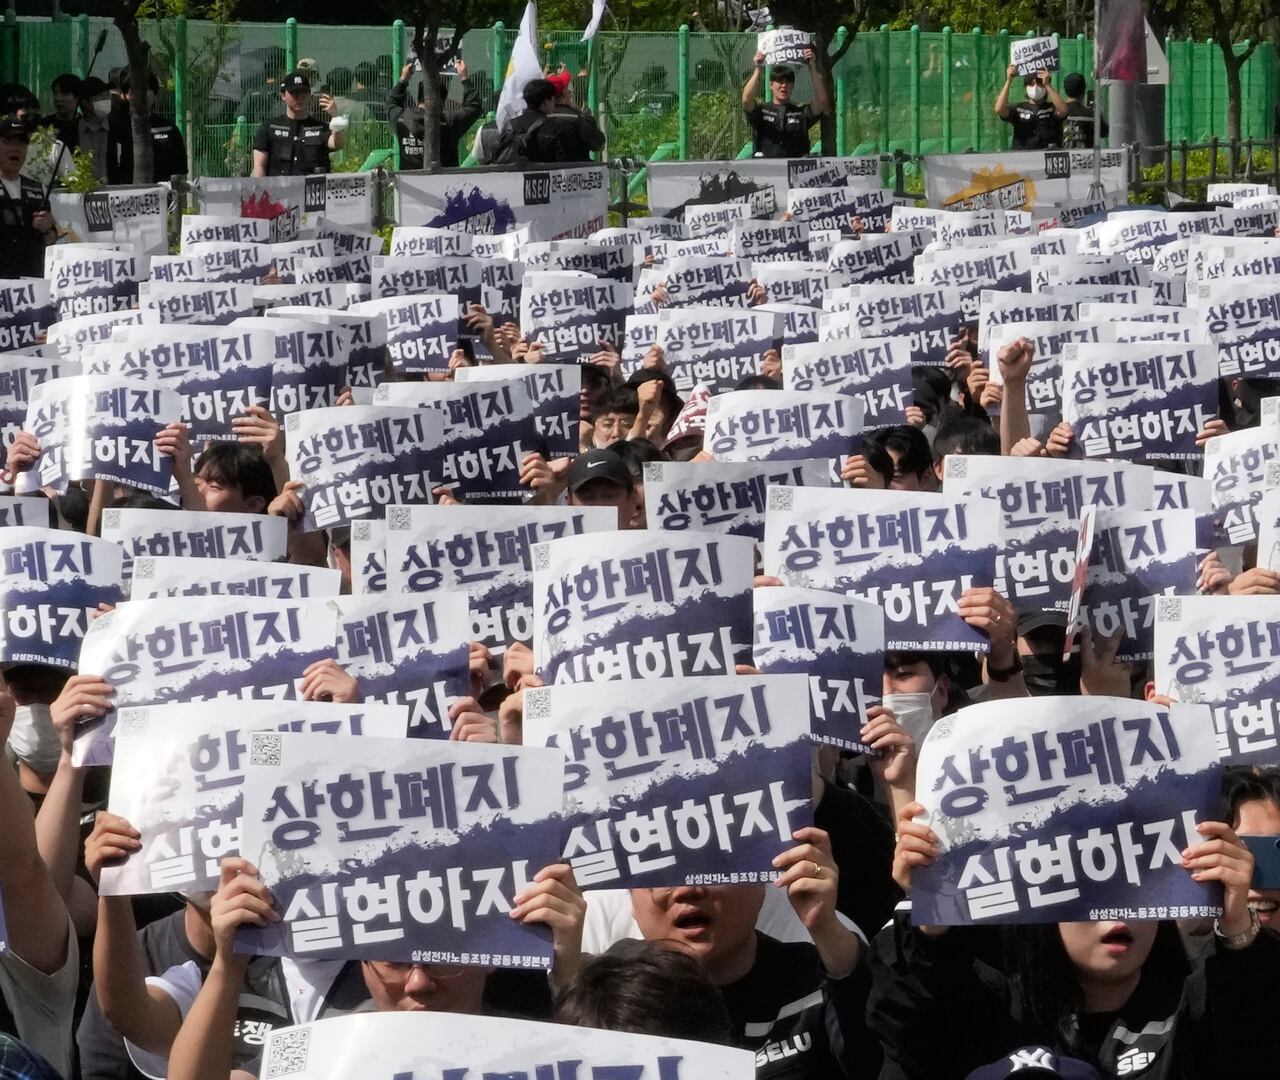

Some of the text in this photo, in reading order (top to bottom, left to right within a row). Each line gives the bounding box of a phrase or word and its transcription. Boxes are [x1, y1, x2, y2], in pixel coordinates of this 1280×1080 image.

[690, 206, 743, 230] 상한폐지
[55, 259, 137, 290] 상한폐지
[378, 265, 470, 295] 상한폐지
[666, 261, 743, 295] 상한폐지
[930, 251, 1016, 287] 상한폐지
[529, 286, 618, 316] 상한폐지
[855, 290, 945, 325] 상한폐지
[662, 316, 758, 350] 상한폐지
[119, 332, 253, 379] 상한폐지
[672, 355, 763, 388] 실현하자
[790, 346, 894, 392] 상한폐지
[1071, 351, 1198, 402] 상한폐지
[295, 414, 424, 474] 상한폐지
[710, 400, 845, 452] 상한폐지
[1079, 404, 1215, 455] 실현하자
[309, 470, 447, 529] 실현하자
[782, 502, 968, 571] 상한폐지
[542, 541, 720, 633] 상한폐지
[12, 653, 70, 667] 삼성전자노동조합
[887, 641, 945, 650] 삼성전자노동조합
[935, 711, 1183, 816] 상한폐지
[262, 756, 520, 849] 상한폐지
[562, 780, 810, 887] 실현하자
[685, 871, 758, 885] 삼성전자노동조합
[956, 809, 1200, 920] 실현하자
[284, 862, 540, 953] 실현하자
[1089, 905, 1223, 920] 삼성전자노동조합 공동투쟁본부
[411, 950, 551, 968] 삼성전자노동조합 공동투쟁본부
[756, 1037, 811, 1068] SELU
